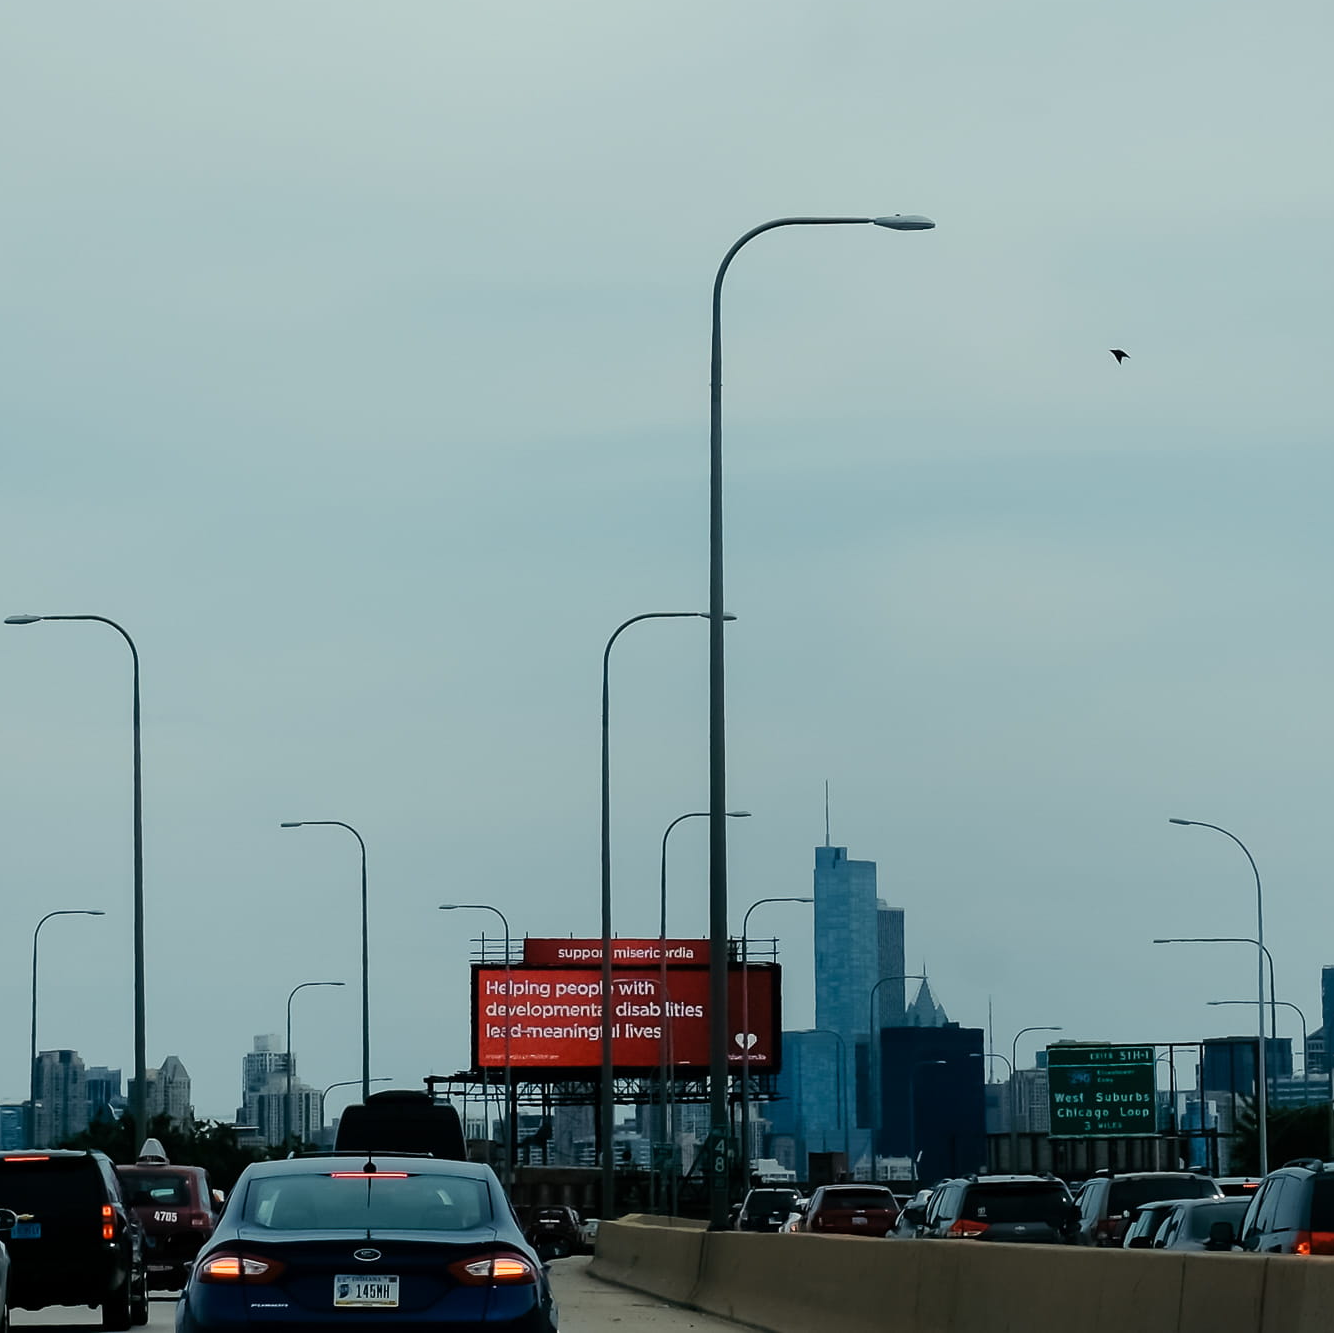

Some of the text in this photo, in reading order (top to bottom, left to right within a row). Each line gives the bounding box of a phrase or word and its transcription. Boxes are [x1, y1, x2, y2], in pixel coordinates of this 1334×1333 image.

[557, 946, 694, 960] suppor misericrdia
[555, 980, 613, 998] peopl
[619, 980, 655, 995] with
[616, 1001, 703, 1017] disablities
[625, 1024, 662, 1038] lives
[1054, 1092, 1150, 1103] West Suburbs
[1057, 1107, 1150, 1120] Chicago Loop
[1084, 1121, 1091, 1131] 3
